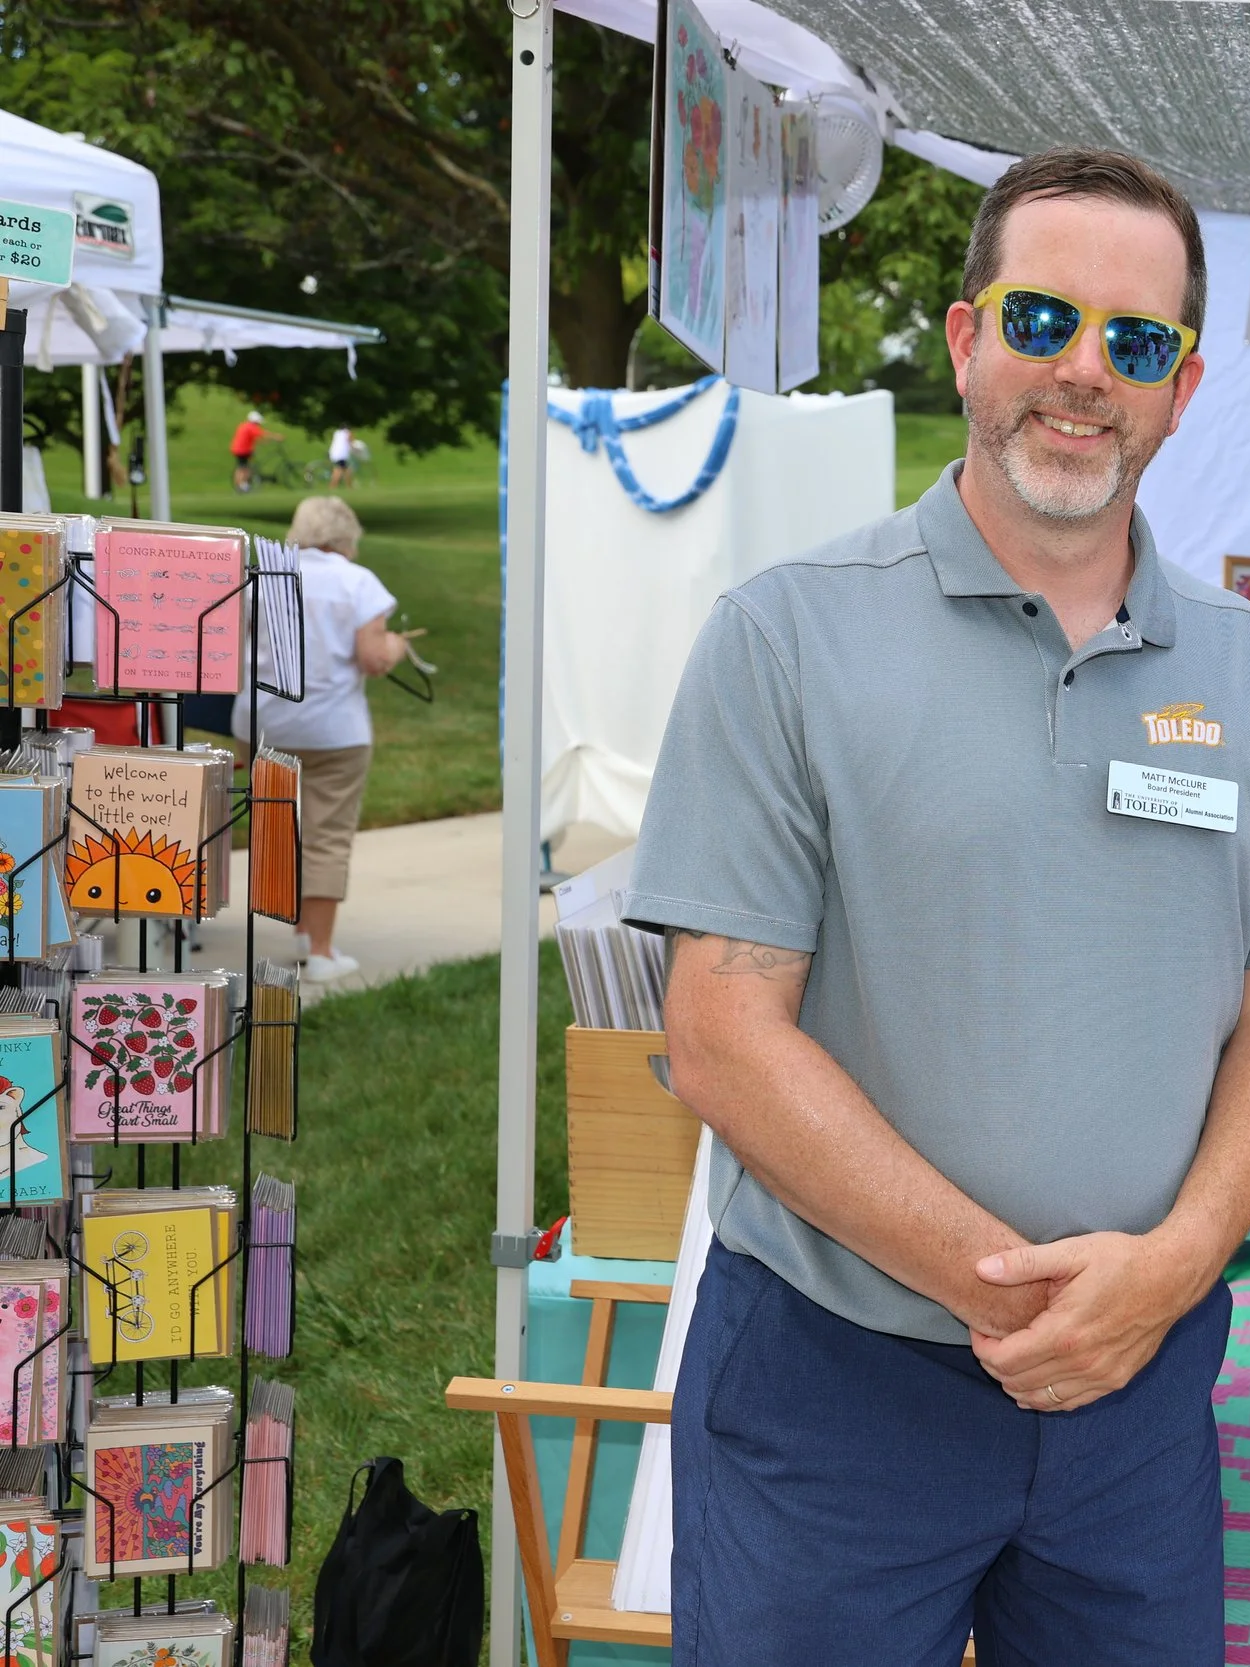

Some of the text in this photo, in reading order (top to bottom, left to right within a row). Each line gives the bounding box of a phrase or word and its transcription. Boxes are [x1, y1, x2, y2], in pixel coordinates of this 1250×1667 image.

[3, 237, 27, 248] each
[10, 251, 41, 267] $20
[118, 546, 231, 561] CONGRATULATIONS
[124, 668, 136, 676] ON
[142, 669, 169, 677] TYING
[175, 671, 192, 679] THE
[1142, 713, 1222, 746] TOLEDO
[1141, 771, 1207, 790] MATT McCLURE
[85, 784, 188, 808] to the world
[1147, 783, 1201, 799] Board President
[92, 803, 134, 824] little
[1124, 798, 1178, 817] TOLEDO
[1185, 807, 1234, 821] Alumni Association
[134, 1100, 172, 1117] Things
[141, 1113, 178, 1128] Small
[186, 1248, 198, 1277] YOU.
[164, 1224, 182, 1344] I'D GO ANYWHERE
[194, 1503, 205, 1519] My
[193, 1521, 203, 1555] You're
